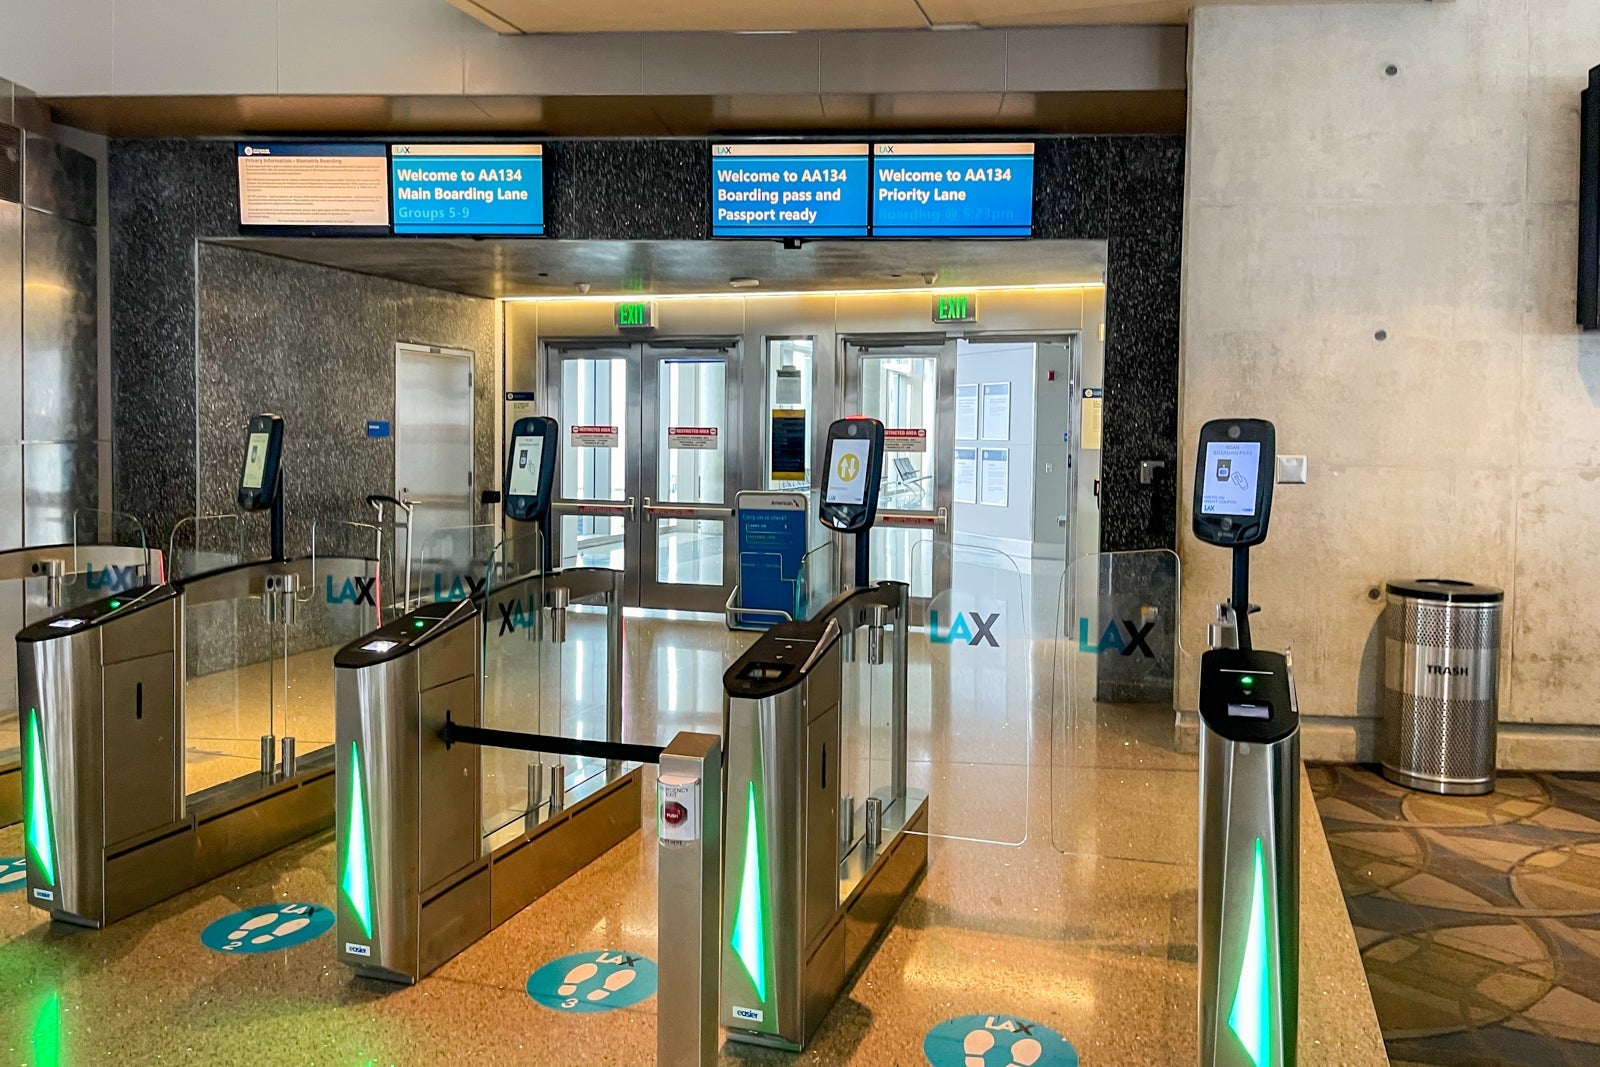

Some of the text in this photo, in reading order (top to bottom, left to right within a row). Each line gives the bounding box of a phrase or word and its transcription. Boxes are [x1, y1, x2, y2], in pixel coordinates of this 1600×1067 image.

[396, 146, 411, 154] LAX
[717, 146, 732, 154] LAX
[878, 145, 894, 154] LAX
[397, 168, 522, 182] Welcome to AA134
[717, 169, 847, 183] Welcome to AA134
[878, 168, 1011, 182] Welcome to AA134
[398, 187, 431, 200] Main
[434, 187, 493, 203] Boarding
[497, 187, 528, 200] Lane
[718, 188, 841, 204] Boarding pass and
[878, 188, 966, 204] Priority Lane
[398, 207, 470, 221] Groups 5-9
[718, 208, 817, 224] Passport ready
[878, 208, 940, 222] Boarding
[620, 303, 644, 325] EXIT
[939, 296, 968, 319] EXIT
[86, 562, 132, 591] LAX
[326, 574, 376, 606] LAX
[434, 573, 486, 603] LAX
[930, 610, 1000, 648] LAX
[1079, 617, 1155, 658] LAX
[1427, 664, 1469, 676] TRASH
[222, 941, 243, 950] 2
[595, 952, 642, 968] LAX
[560, 998, 579, 1009] 3
[736, 1009, 759, 1019] easier
[984, 1016, 1035, 1036] LAX
